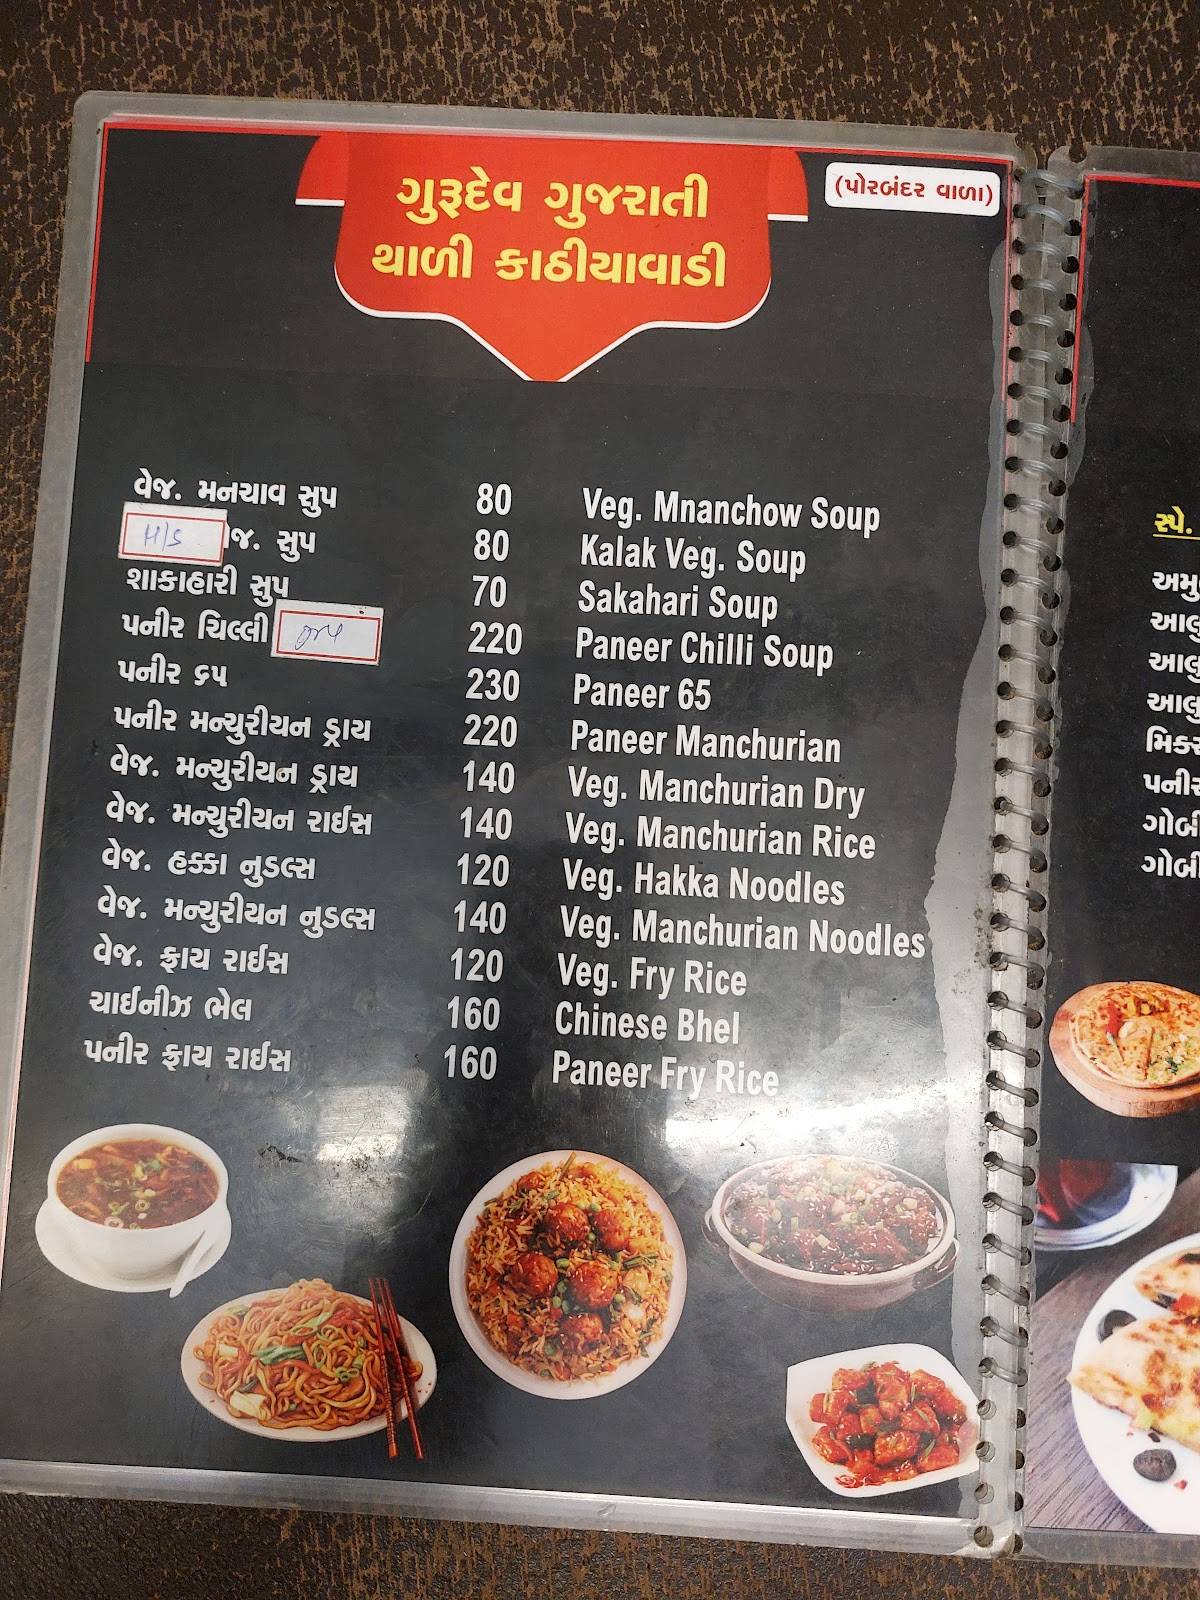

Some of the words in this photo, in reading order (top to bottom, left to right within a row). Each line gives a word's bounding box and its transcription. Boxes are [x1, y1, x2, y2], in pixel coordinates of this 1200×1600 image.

[544, 174, 708, 229] ગુજરાતી
[836, 172, 925, 200] (પોરબંદર
[934, 182, 992, 206] વાળા)
[372, 233, 472, 278] થાળી
[495, 237, 725, 286] કાઠીયાવાડી
[134, 468, 181, 500] વેજ.
[198, 481, 285, 505] મનચાવ
[298, 486, 336, 517] સુપ
[477, 483, 511, 515] 80
[583, 488, 641, 528] Veg.
[655, 491, 802, 527] Mnanchow
[811, 497, 879, 538] Soup
[277, 531, 315, 562] સુપ
[474, 529, 509, 561] 80
[581, 534, 656, 568] Kalak
[665, 538, 724, 578] Veg.
[737, 540, 805, 582] Soup
[127, 564, 237, 595] શાકાહારી
[250, 576, 290, 607] સુપ
[473, 576, 506, 607] 70
[579, 580, 698, 616] Sakahari
[709, 586, 777, 627] Soup
[122, 607, 184, 638] પનીર
[198, 610, 268, 642] ચિલ્લી
[468, 622, 522, 655] 220
[118, 653, 181, 684] પનીર
[577, 627, 672, 661] Paneer
[681, 632, 753, 665] Chilli
[764, 635, 832, 676] Soup
[466, 668, 519, 701] 230
[574, 674, 670, 708] Paneer
[678, 678, 710, 710] 65
[114, 699, 177, 730] પનીર
[190, 705, 311, 745] મન્યુરીયન
[323, 718, 370, 747] ડ્રાય
[463, 714, 517, 747] 220
[572, 720, 667, 754] Paneer
[676, 725, 840, 762] Manchurian
[111, 744, 158, 776] વેજ.
[176, 751, 297, 791] મન્યુરીયન
[310, 764, 357, 793] ડ્રાય
[464, 761, 514, 793] 140
[568, 766, 626, 807] Veg.
[640, 770, 803, 808] Manchurian
[815, 778, 865, 819] Dry
[107, 791, 155, 823] વેજ.
[172, 798, 294, 838] મન્યુરીયન
[307, 805, 372, 834] રાઈસ
[461, 807, 512, 840] 140
[566, 812, 624, 853] Veg.
[638, 816, 801, 855] Manchurian
[813, 825, 875, 859] Rice
[102, 838, 150, 871] વેજ.
[168, 851, 227, 875] હક્કા
[240, 856, 315, 887] નુડલ્સ
[458, 853, 509, 887] 120
[563, 858, 622, 900] Veg.
[635, 862, 718, 897] Hakka
[730, 868, 844, 905] Noodles
[98, 885, 146, 918] વેજ.
[165, 892, 287, 933] મન્યુરીયન
[300, 906, 375, 938] નુડલ્સ
[454, 900, 506, 934] 140
[561, 906, 619, 948] Veg.
[633, 910, 798, 950] Manchurian
[810, 920, 925, 958] Noodles
[94, 933, 142, 966] વેજ.
[160, 947, 210, 973] ફ્રાય
[223, 944, 288, 974] રાઈસ
[451, 948, 503, 982] 120
[558, 953, 617, 996] Veg.
[631, 957, 675, 1000] Fry
[685, 960, 746, 996] Rice
[89, 985, 192, 1017] ચાઈનીઝ
[205, 988, 251, 1020] ભેલ
[448, 996, 499, 1030] 160
[556, 1001, 667, 1040] Chinese
[678, 1008, 739, 1044] Bhel
[84, 1032, 148, 1064] પનીર
[162, 1044, 212, 1071] ફ્રાય
[226, 1041, 291, 1071] રાઈસ
[444, 1045, 496, 1080] 160
[553, 1050, 652, 1088] Paneer
[661, 1057, 706, 1100] Fry
[716, 1060, 779, 1097] Rice
